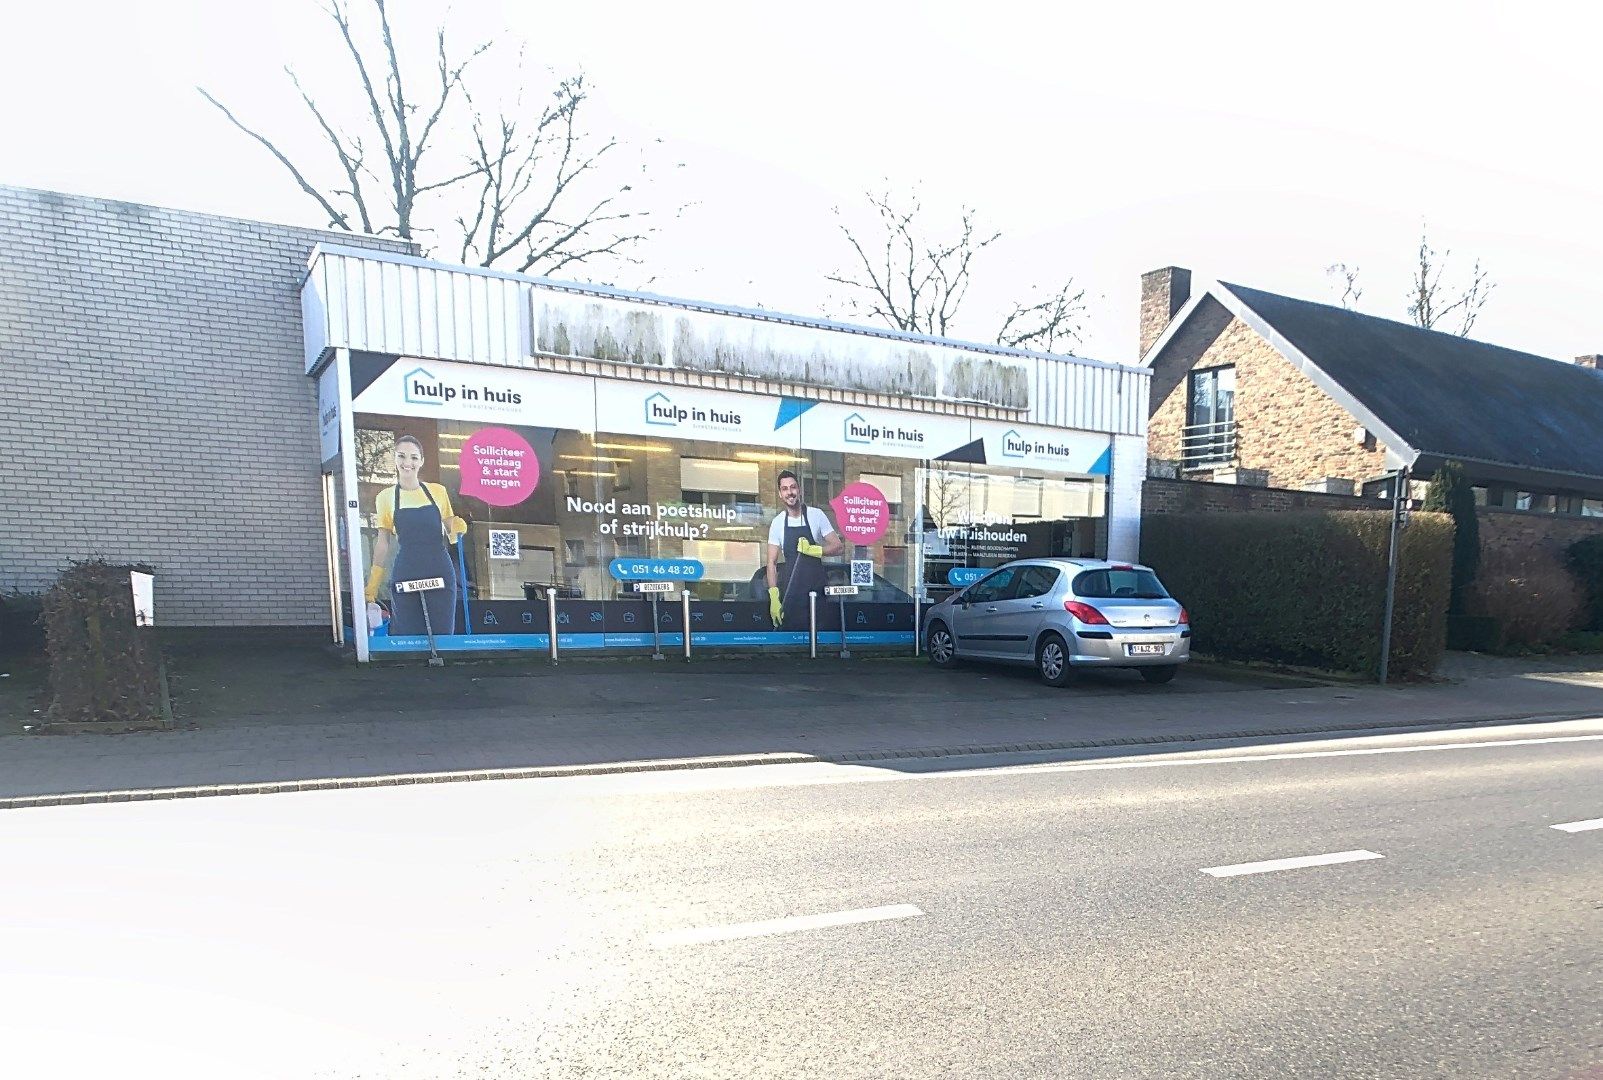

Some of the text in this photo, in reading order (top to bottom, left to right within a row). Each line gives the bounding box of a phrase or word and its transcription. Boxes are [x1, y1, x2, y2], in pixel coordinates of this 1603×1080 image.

[413, 380, 522, 405] hulp in huis
[652, 403, 742, 425] hulp in huis
[850, 423, 924, 442] hulp in huis
[473, 445, 525, 457] Solliciteer
[1007, 439, 1070, 457] hulp in huis
[478, 457, 522, 469] vandaag
[482, 467, 518, 477] & start
[480, 478, 521, 489] morgen
[843, 495, 882, 506] Solliciteer
[566, 496, 737, 524] Nood aan poetshulp
[846, 506, 880, 517] vandaag
[849, 514, 877, 524] & start
[600, 519, 709, 541] of strijkhulp?
[845, 525, 876, 534] morgen
[632, 564, 695, 575] 051 46 48 20
[964, 573, 977, 581] 051
[396, 583, 402, 591] P
[634, 583, 640, 592] P
